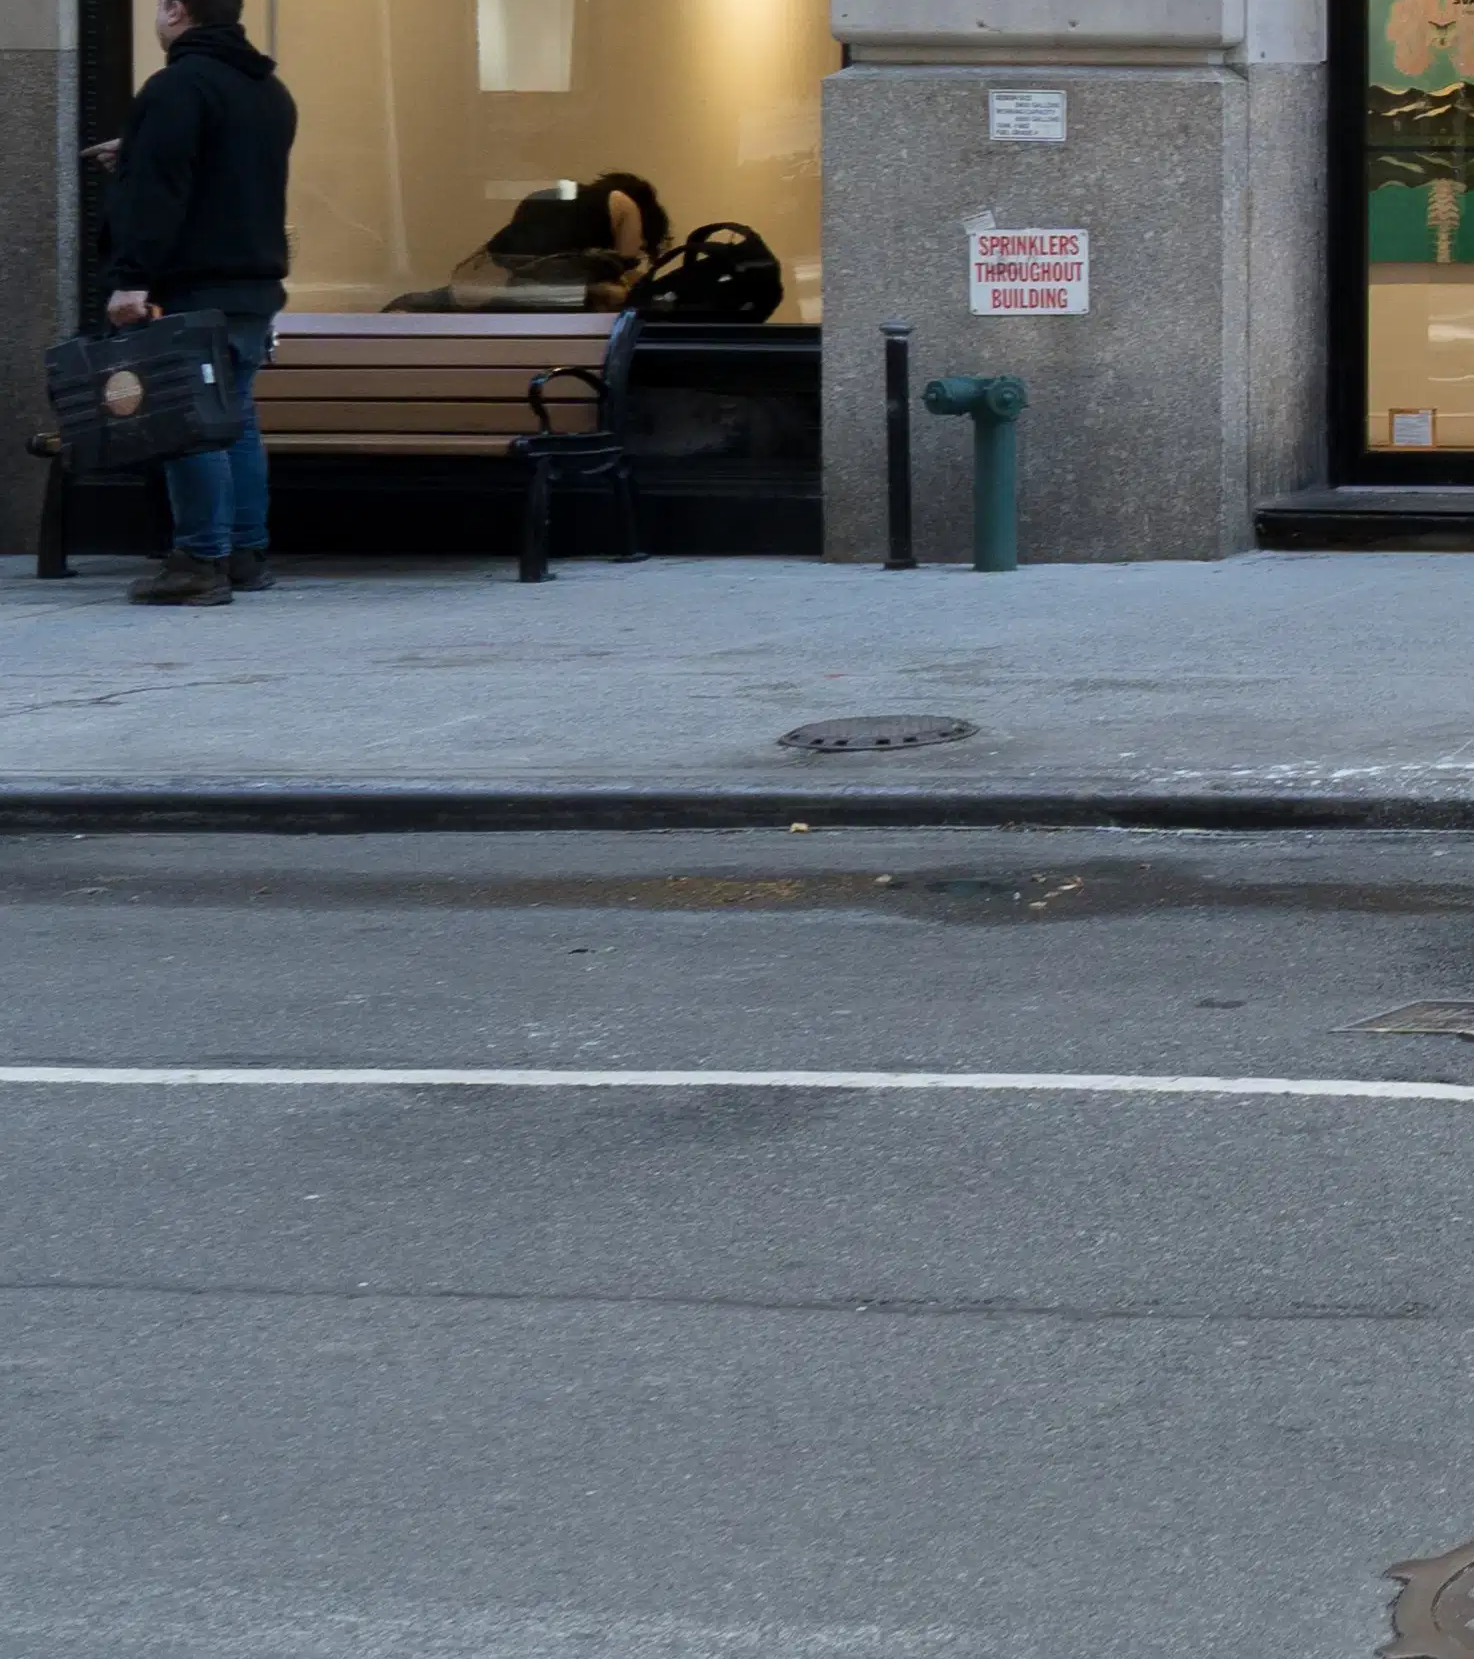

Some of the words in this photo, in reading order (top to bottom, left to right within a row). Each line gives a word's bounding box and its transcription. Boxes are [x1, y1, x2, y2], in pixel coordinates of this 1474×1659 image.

[978, 234, 1080, 257] SPRINKLERS
[975, 261, 1084, 283] THROUGHOUT
[991, 288, 1068, 310] BUILDING
